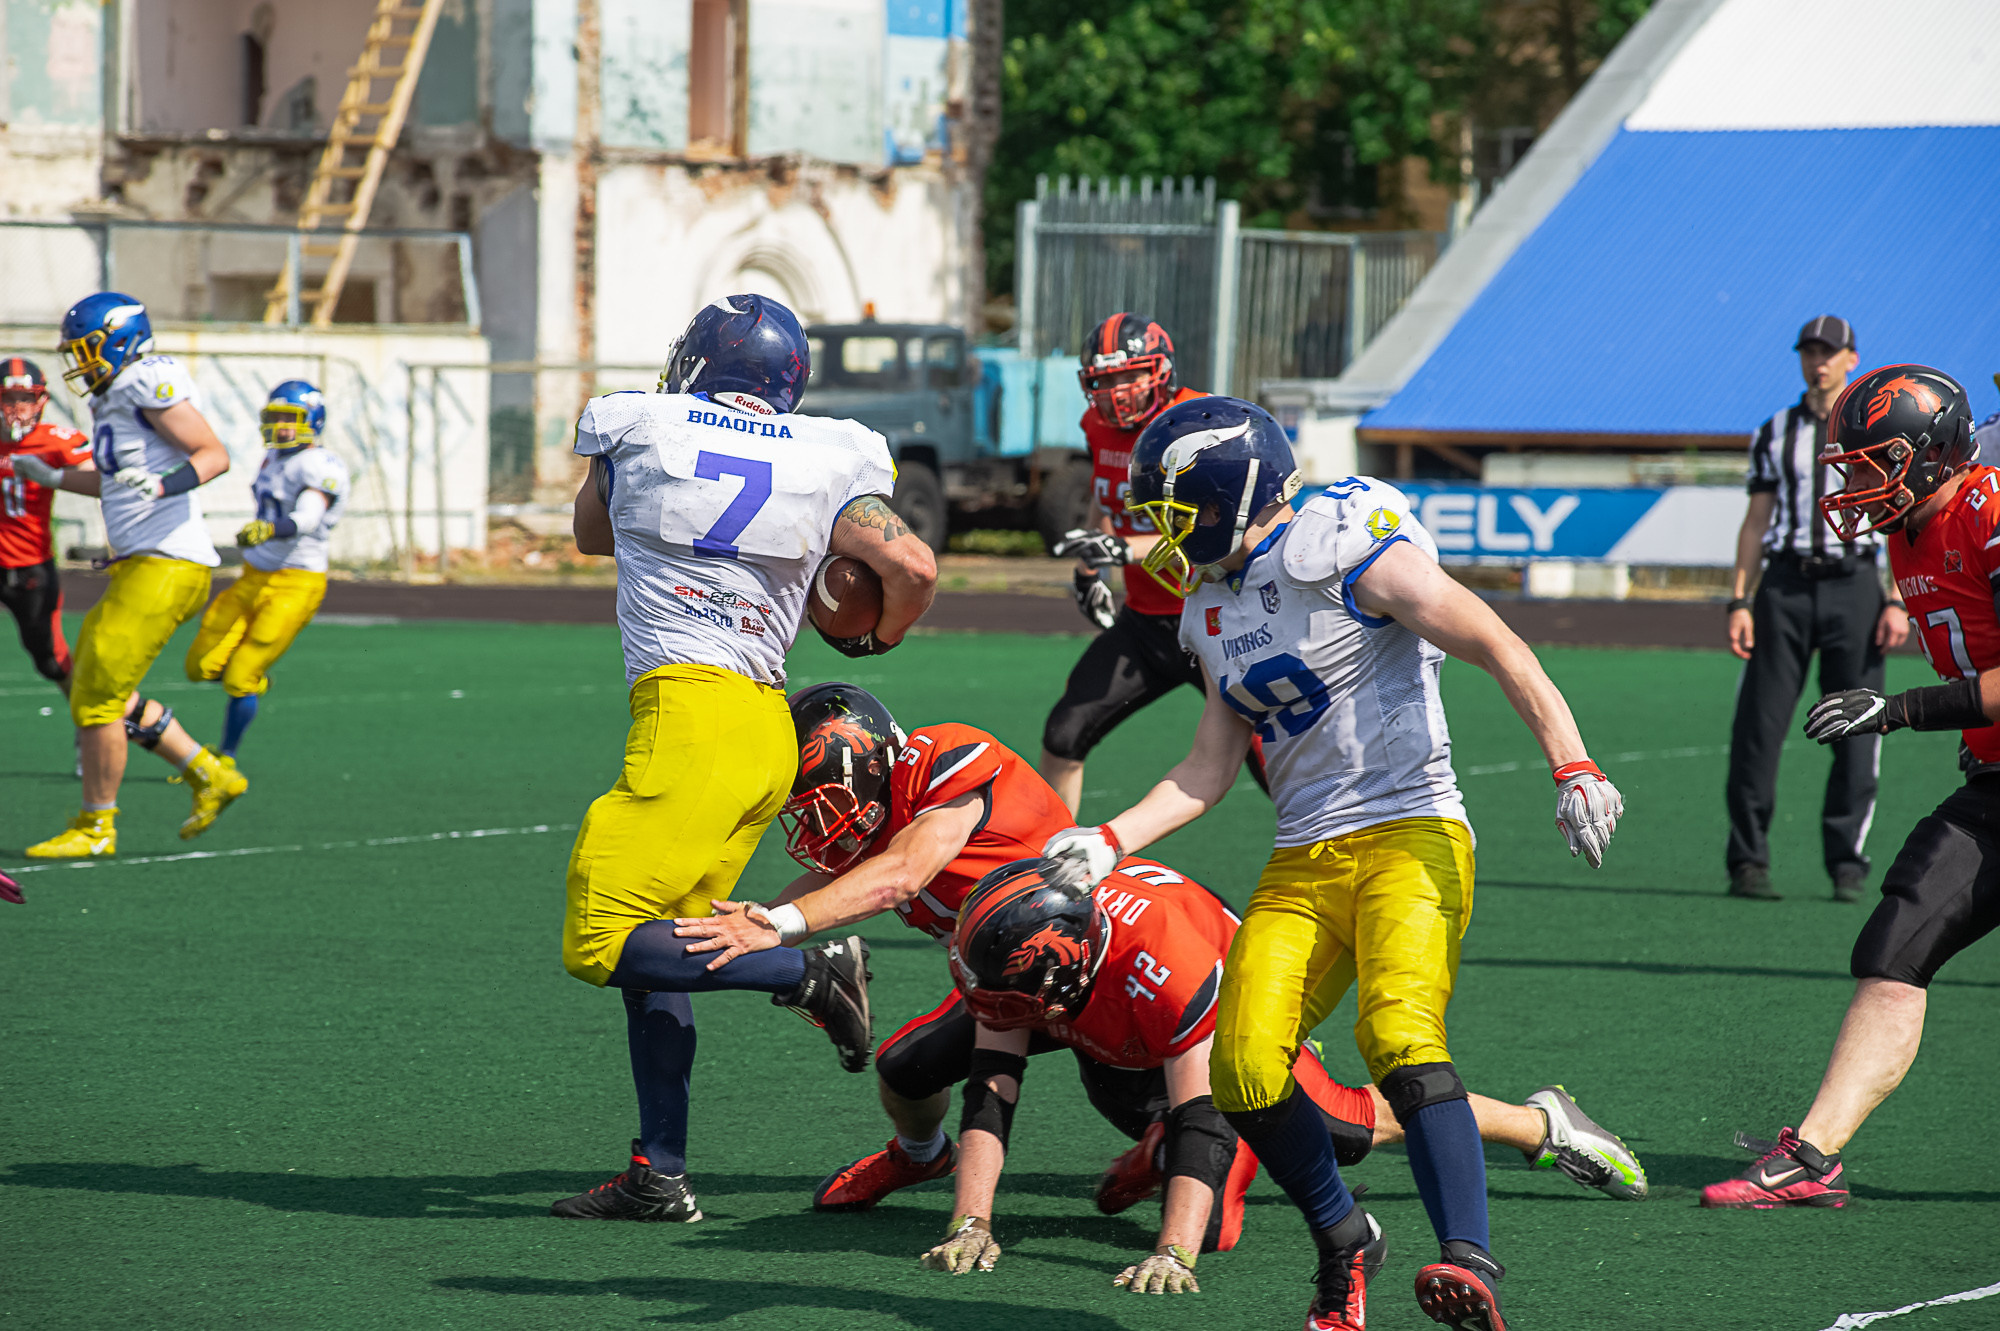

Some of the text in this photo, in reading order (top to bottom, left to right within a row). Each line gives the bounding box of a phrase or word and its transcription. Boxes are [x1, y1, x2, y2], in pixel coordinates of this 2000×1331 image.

[686, 409, 794, 439] ВОЛОГДА
[692, 449, 773, 560] 7
[1965, 471, 2000, 512] 27
[1410, 493, 1581, 552] ELY
[1221, 622, 1274, 661] VIKINGS
[896, 733, 935, 767] 51
[1124, 950, 1172, 1002] 42
